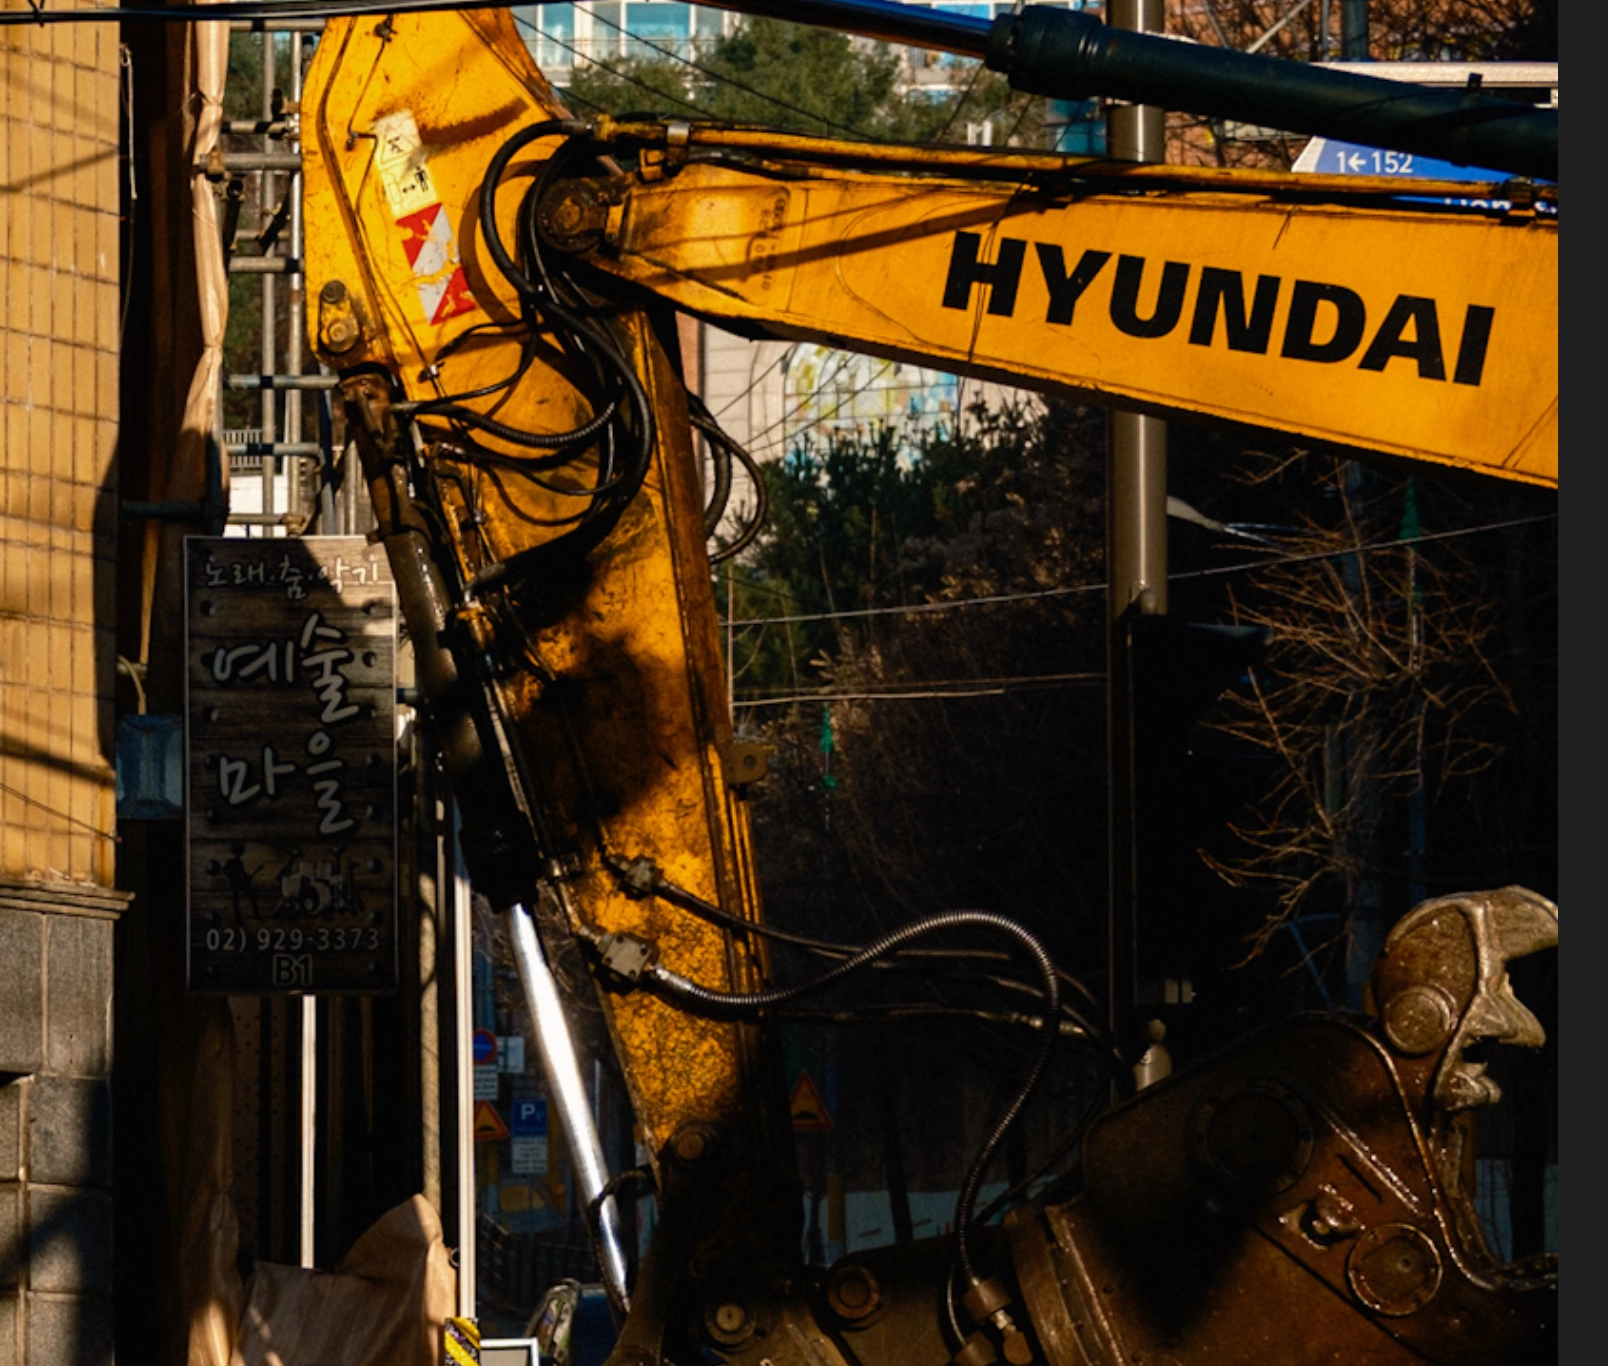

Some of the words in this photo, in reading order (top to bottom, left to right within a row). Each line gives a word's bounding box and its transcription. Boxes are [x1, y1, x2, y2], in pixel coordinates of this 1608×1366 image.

[941, 230, 1496, 387] HYUNDAI
[213, 613, 361, 723] 예술
[219, 731, 356, 835] 마을
[272, 953, 313, 986] B1
[521, 1103, 536, 1121] P
